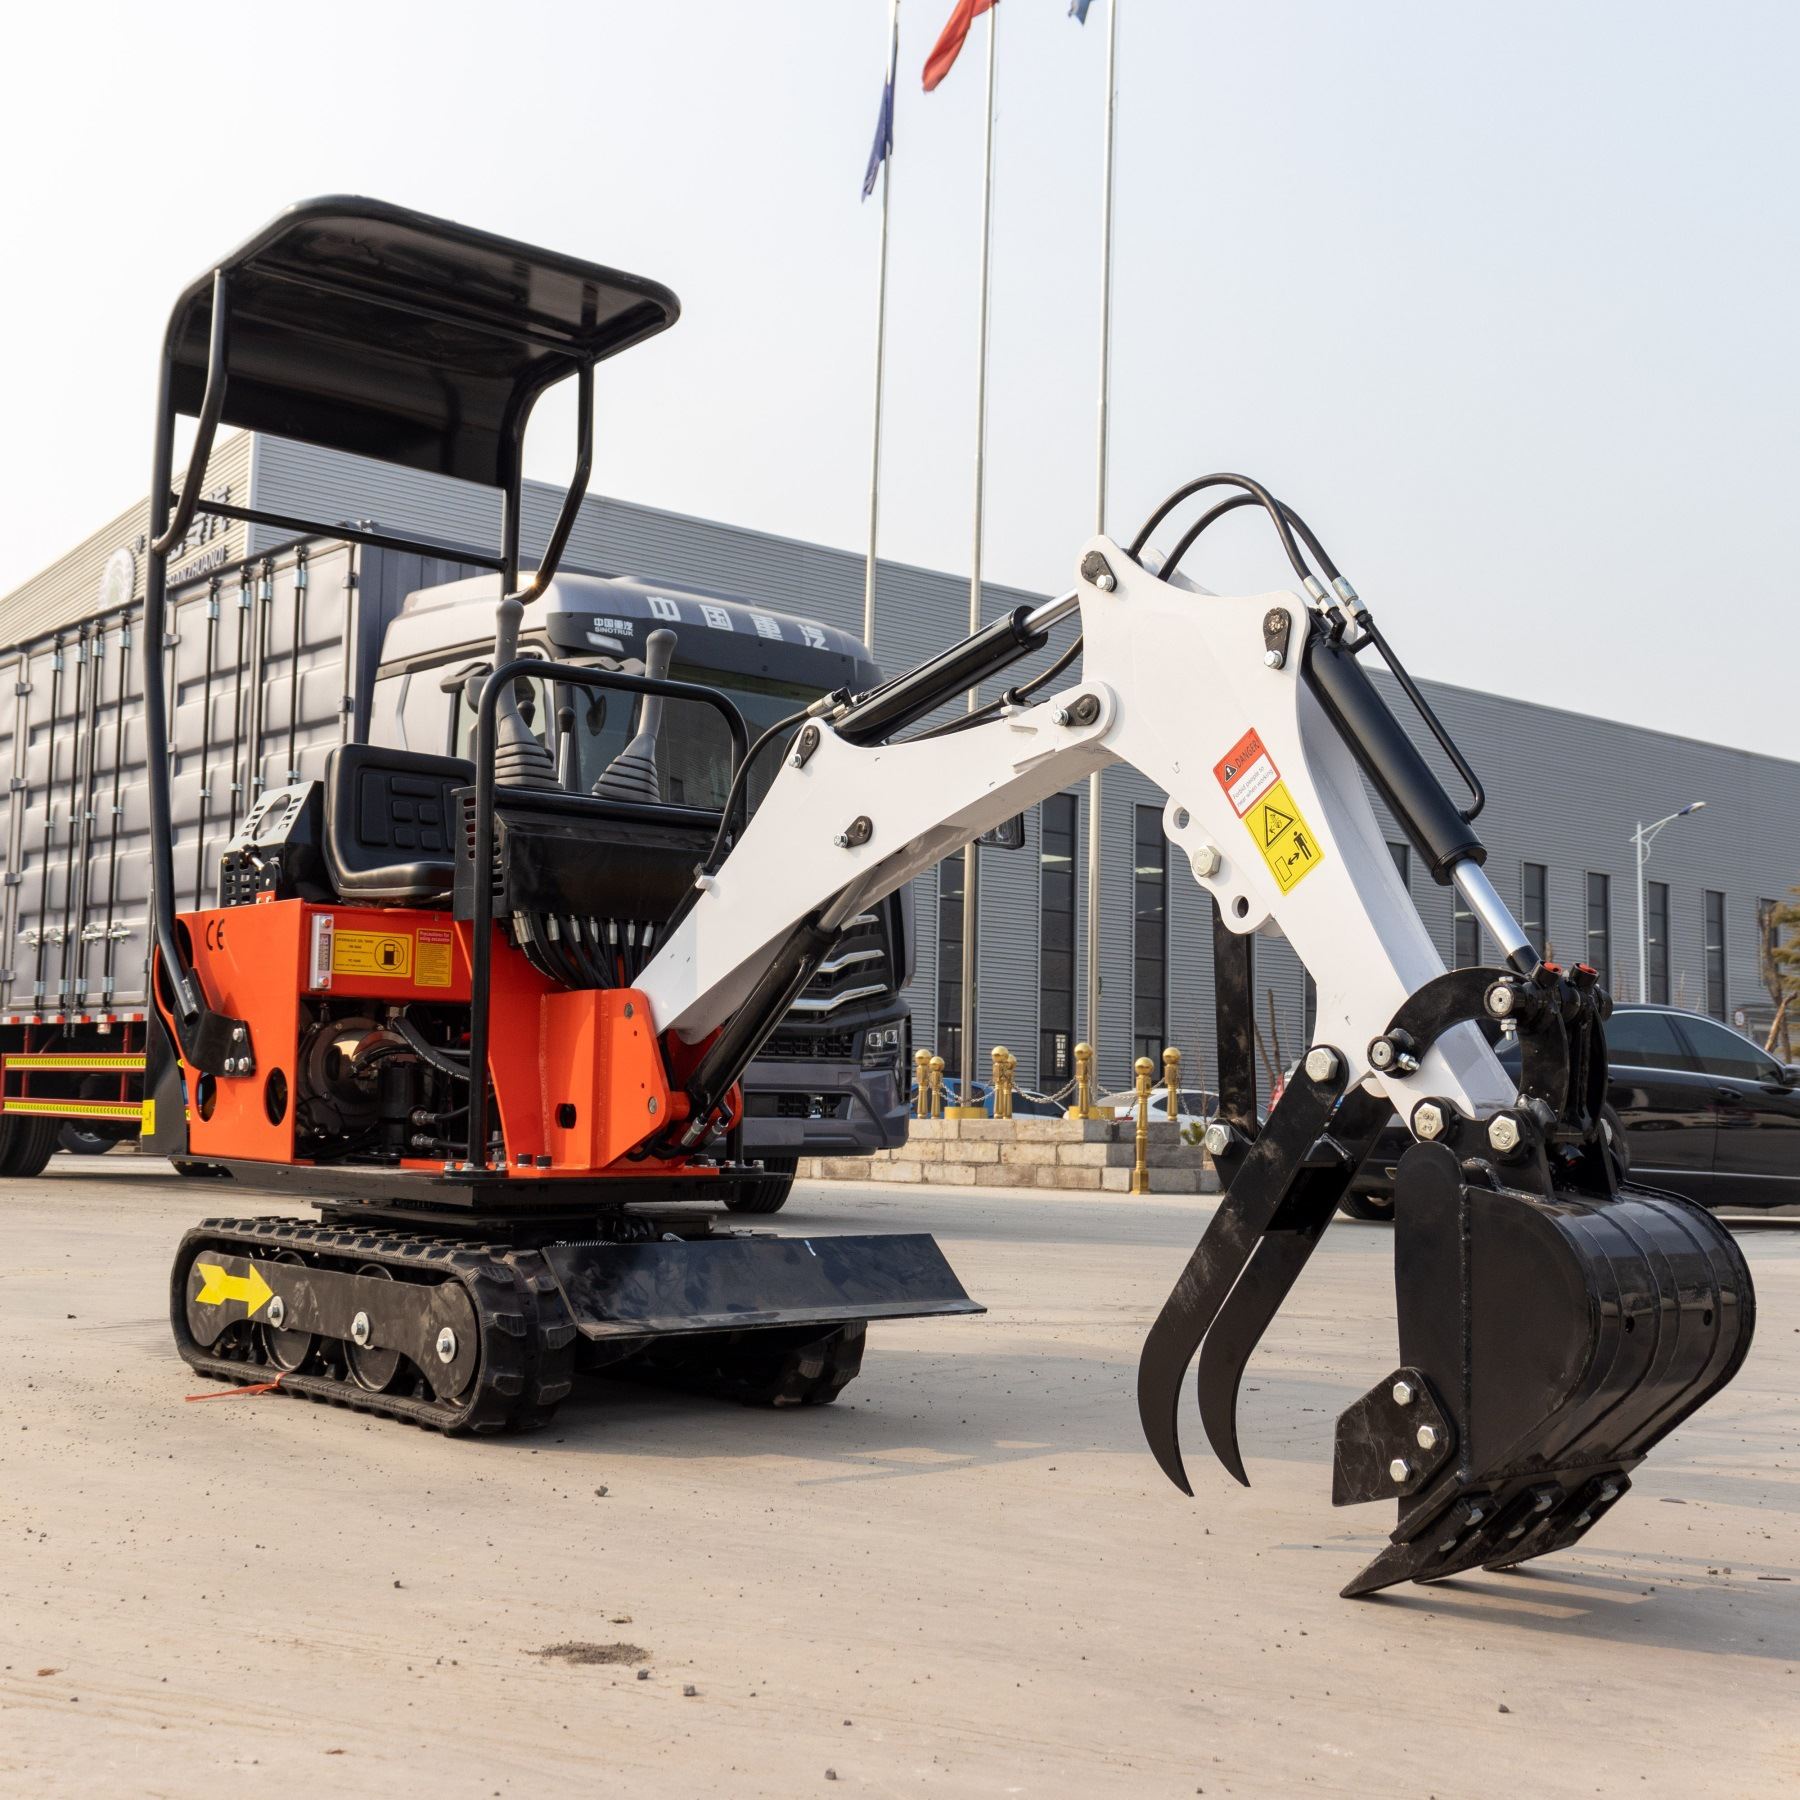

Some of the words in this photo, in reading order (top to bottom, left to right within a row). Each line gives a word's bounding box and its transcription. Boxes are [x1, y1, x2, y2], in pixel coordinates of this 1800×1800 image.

[594, 617, 633, 630] 中国重汽
[594, 626, 634, 637] SINOTRUK
[646, 596, 829, 651] 中国重汽
[1235, 740, 1260, 769] DANGER
[206, 919, 225, 951] CE
